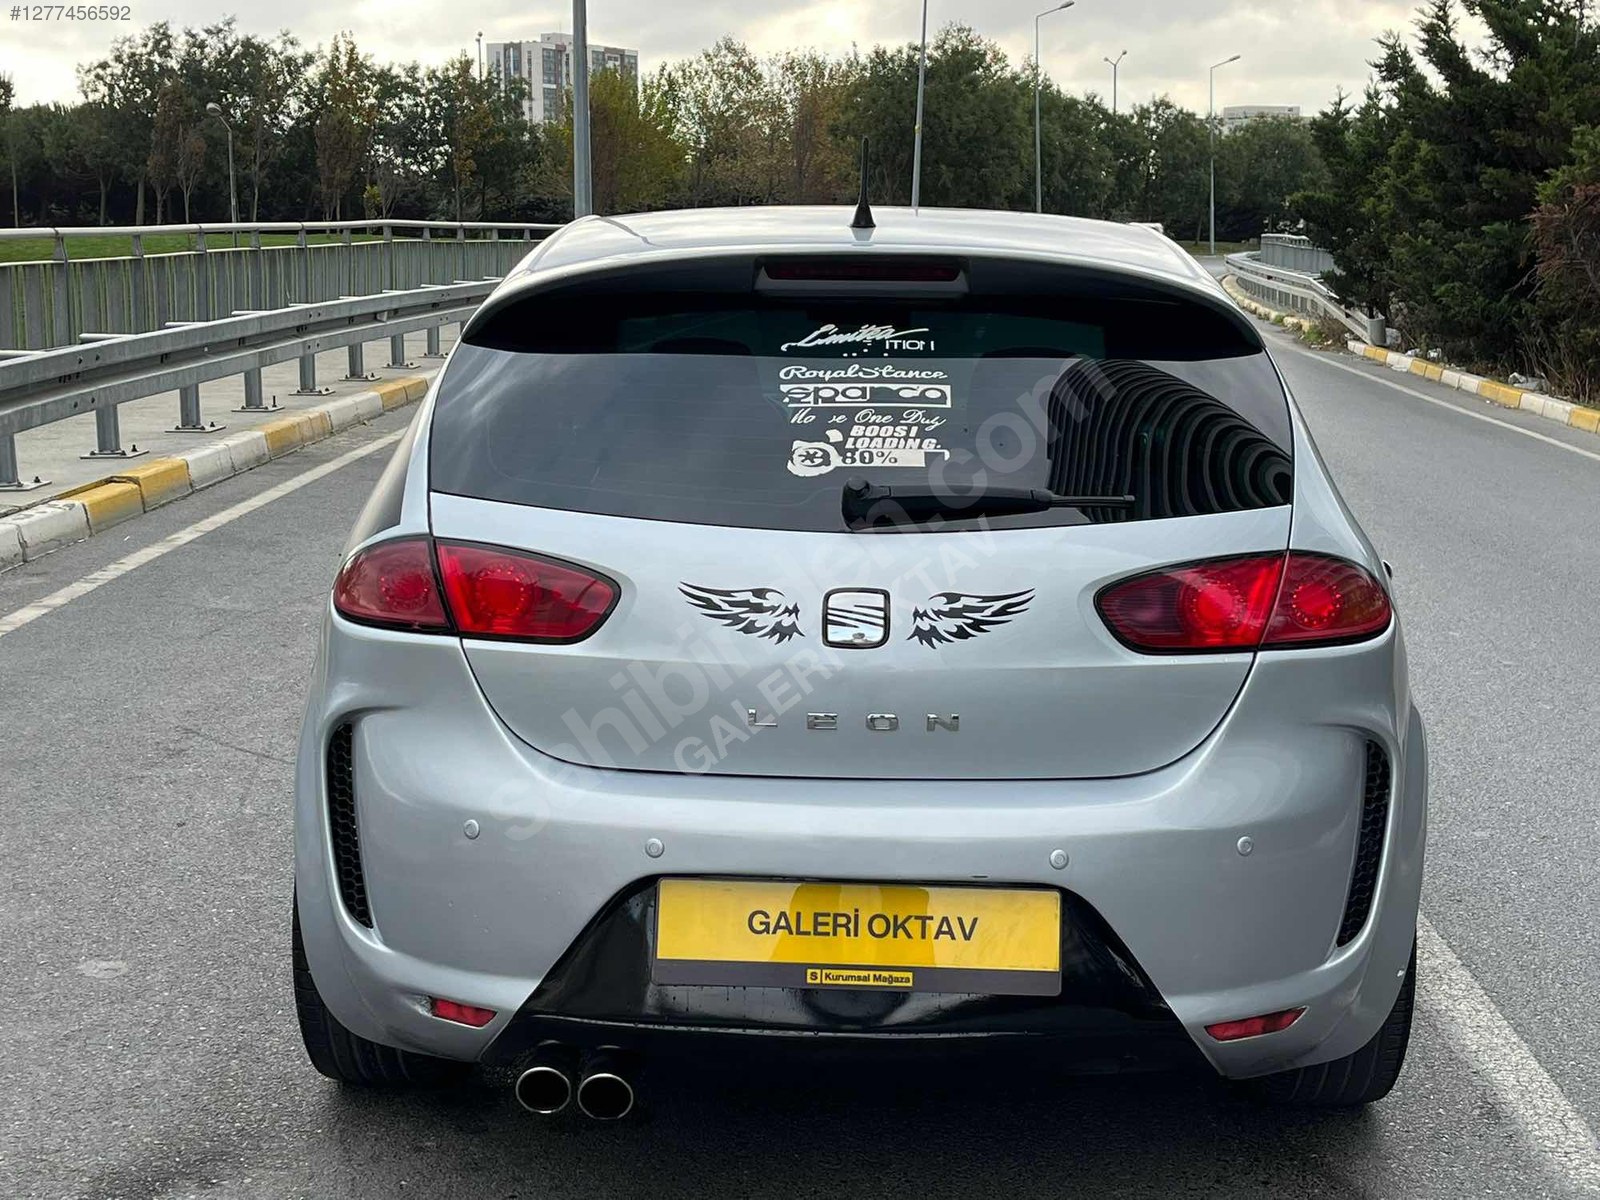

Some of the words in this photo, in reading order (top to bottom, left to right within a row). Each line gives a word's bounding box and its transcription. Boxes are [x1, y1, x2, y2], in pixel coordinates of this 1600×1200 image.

[854, 409, 893, 424] One
[749, 709, 960, 732] LEON
[748, 908, 859, 937] GALERİ
[867, 914, 979, 941] OKTAV
[824, 972, 871, 982] Kurumsal
[873, 974, 911, 985] Mağaza
